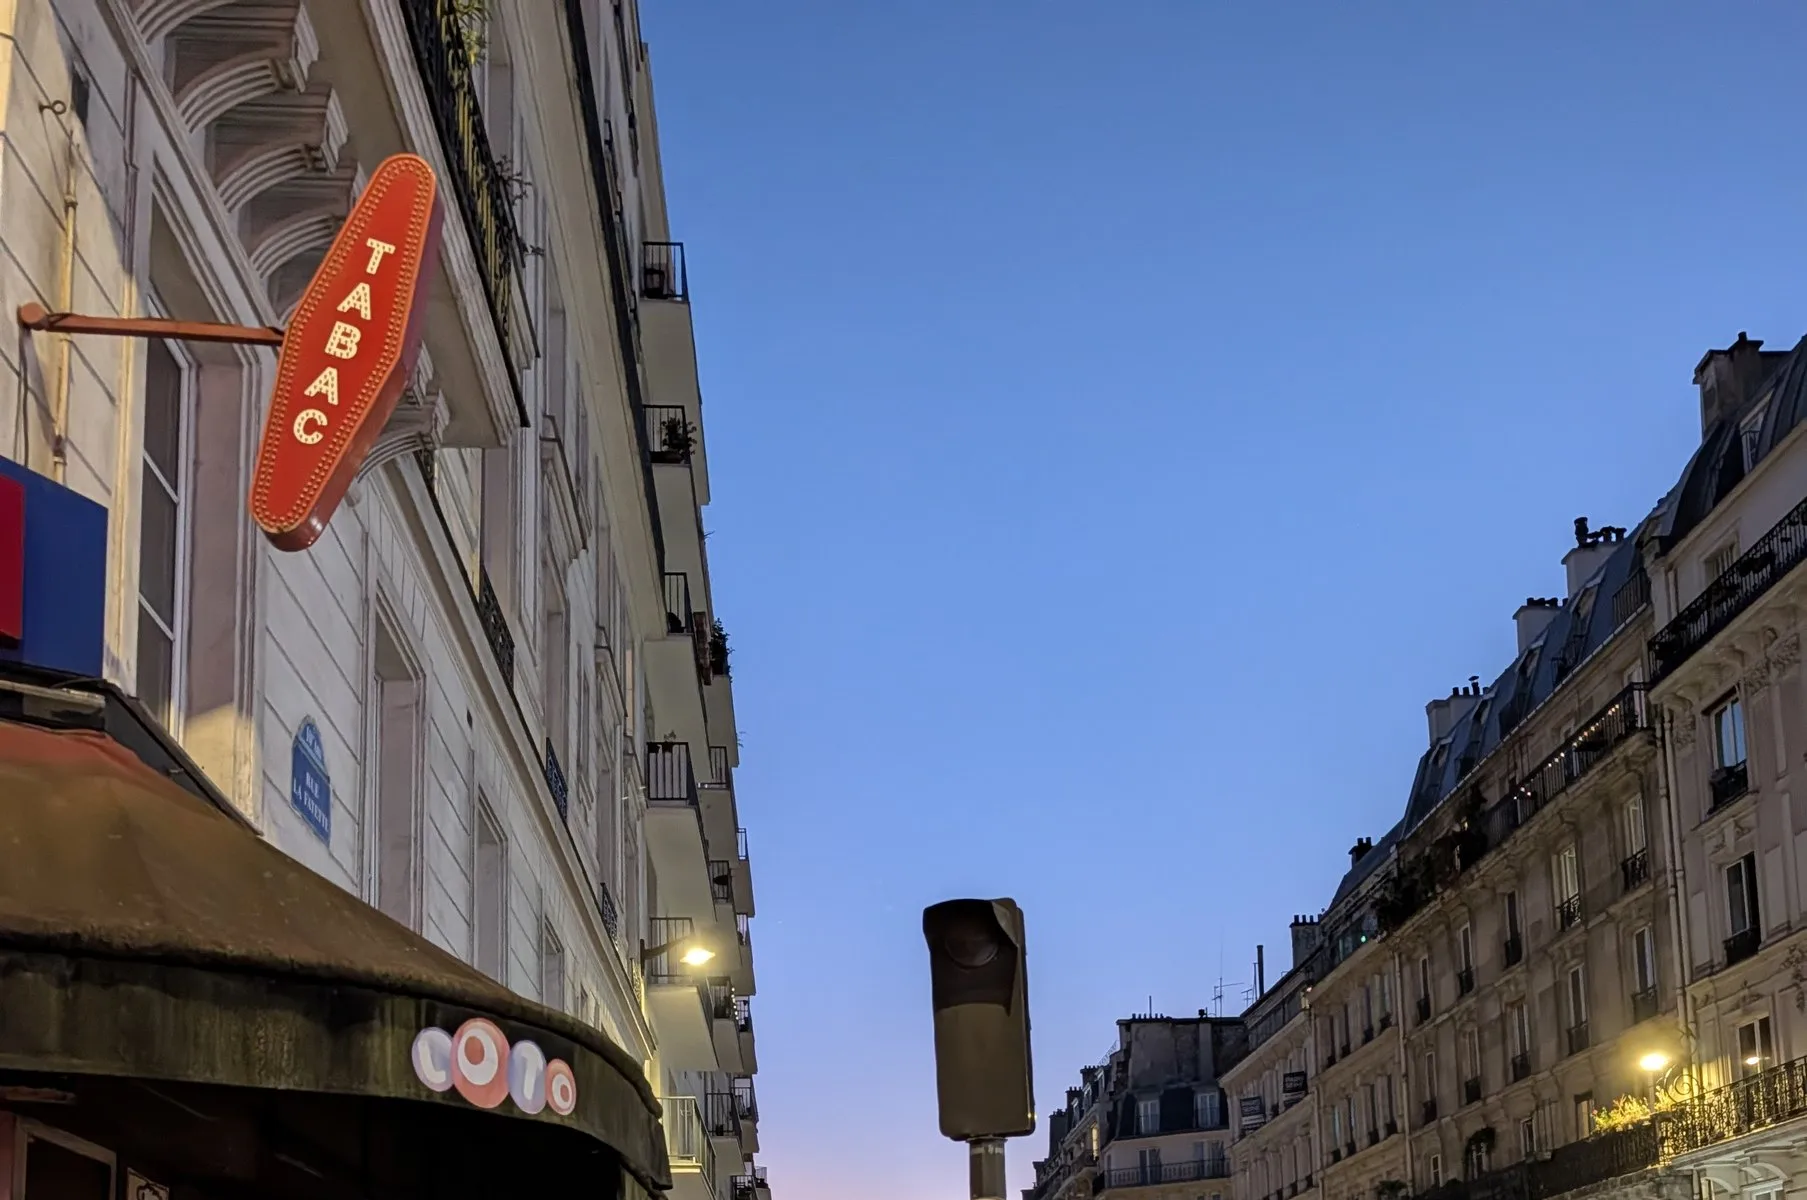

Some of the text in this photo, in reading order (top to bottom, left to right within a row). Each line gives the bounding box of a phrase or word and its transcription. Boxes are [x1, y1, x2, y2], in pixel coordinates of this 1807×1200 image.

[293, 238, 395, 445] TABAC
[293, 778, 303, 801] LA
[417, 1026, 573, 1110] LOTO
